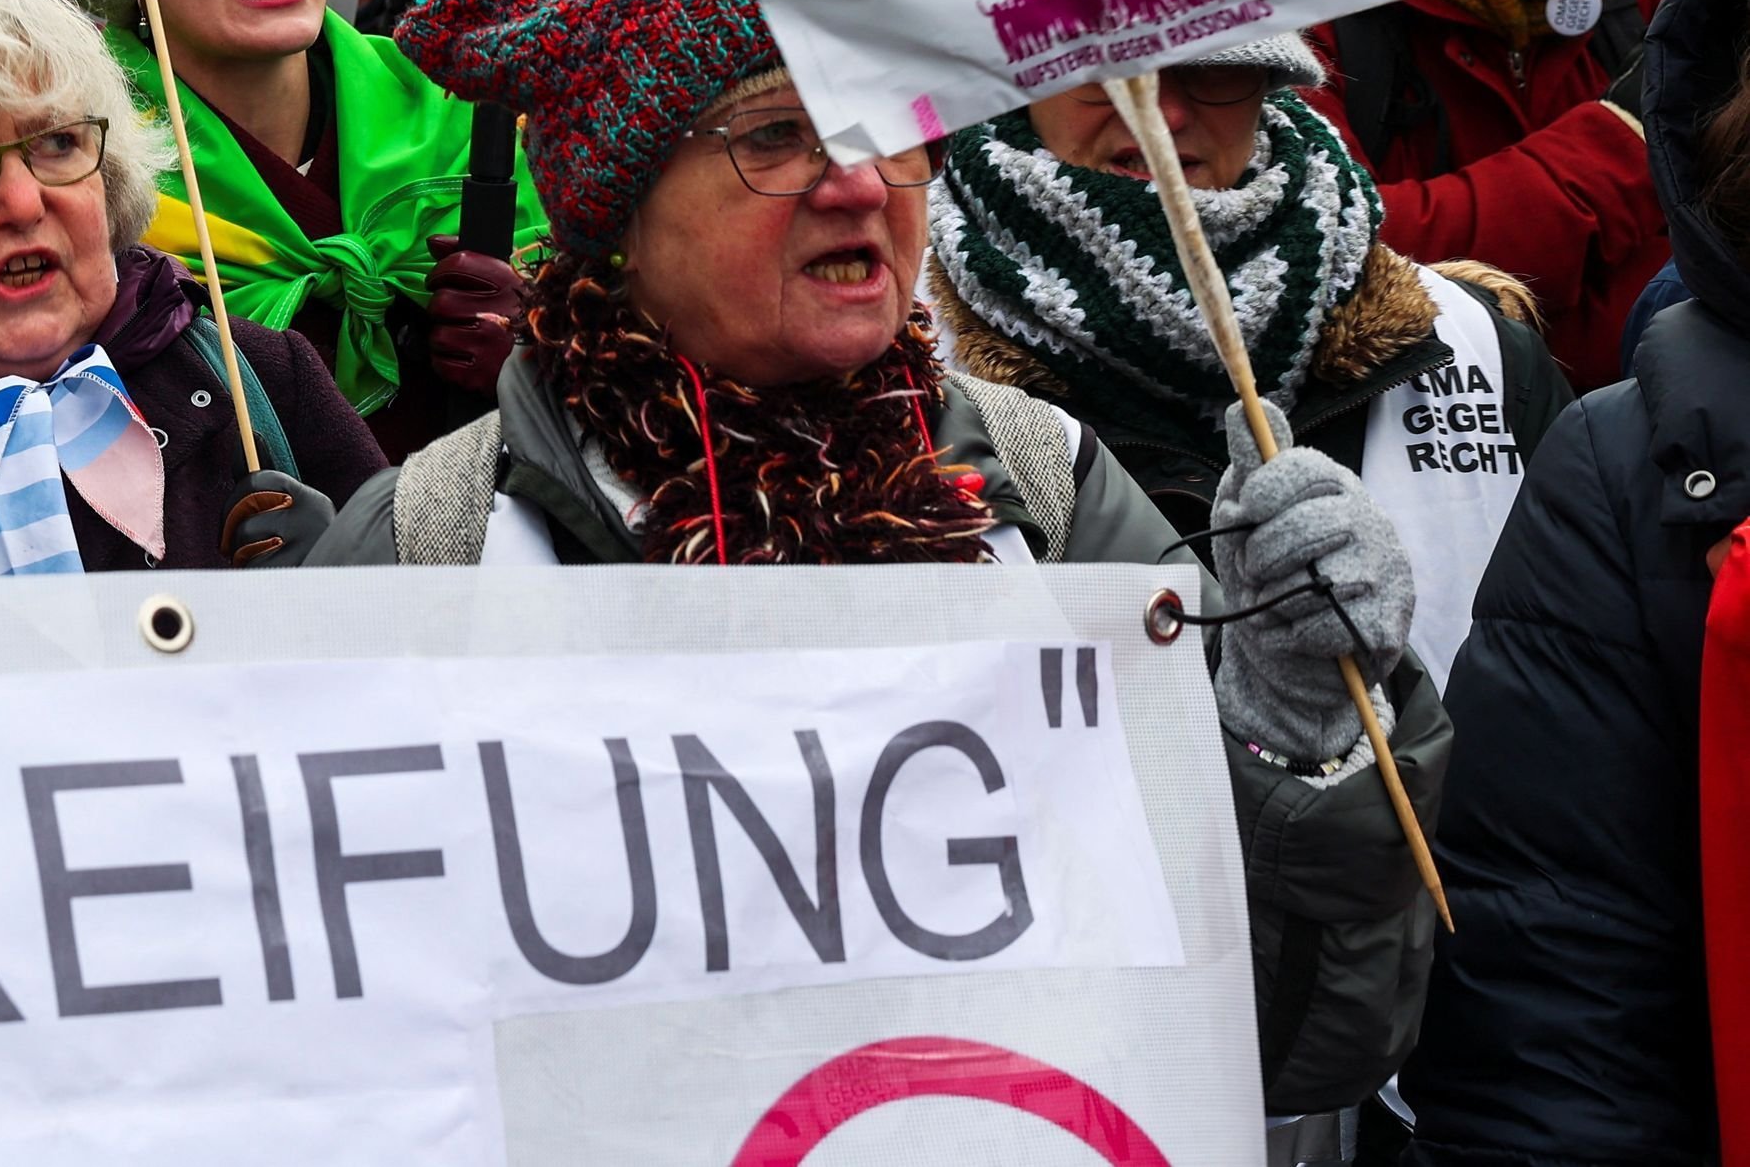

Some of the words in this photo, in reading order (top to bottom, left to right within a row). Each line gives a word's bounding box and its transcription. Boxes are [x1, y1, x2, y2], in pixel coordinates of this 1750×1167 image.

[1015, 44, 1104, 90] AUFSTEHEN
[1108, 32, 1166, 63] GEGEN
[1403, 403, 1512, 436] GEGE
